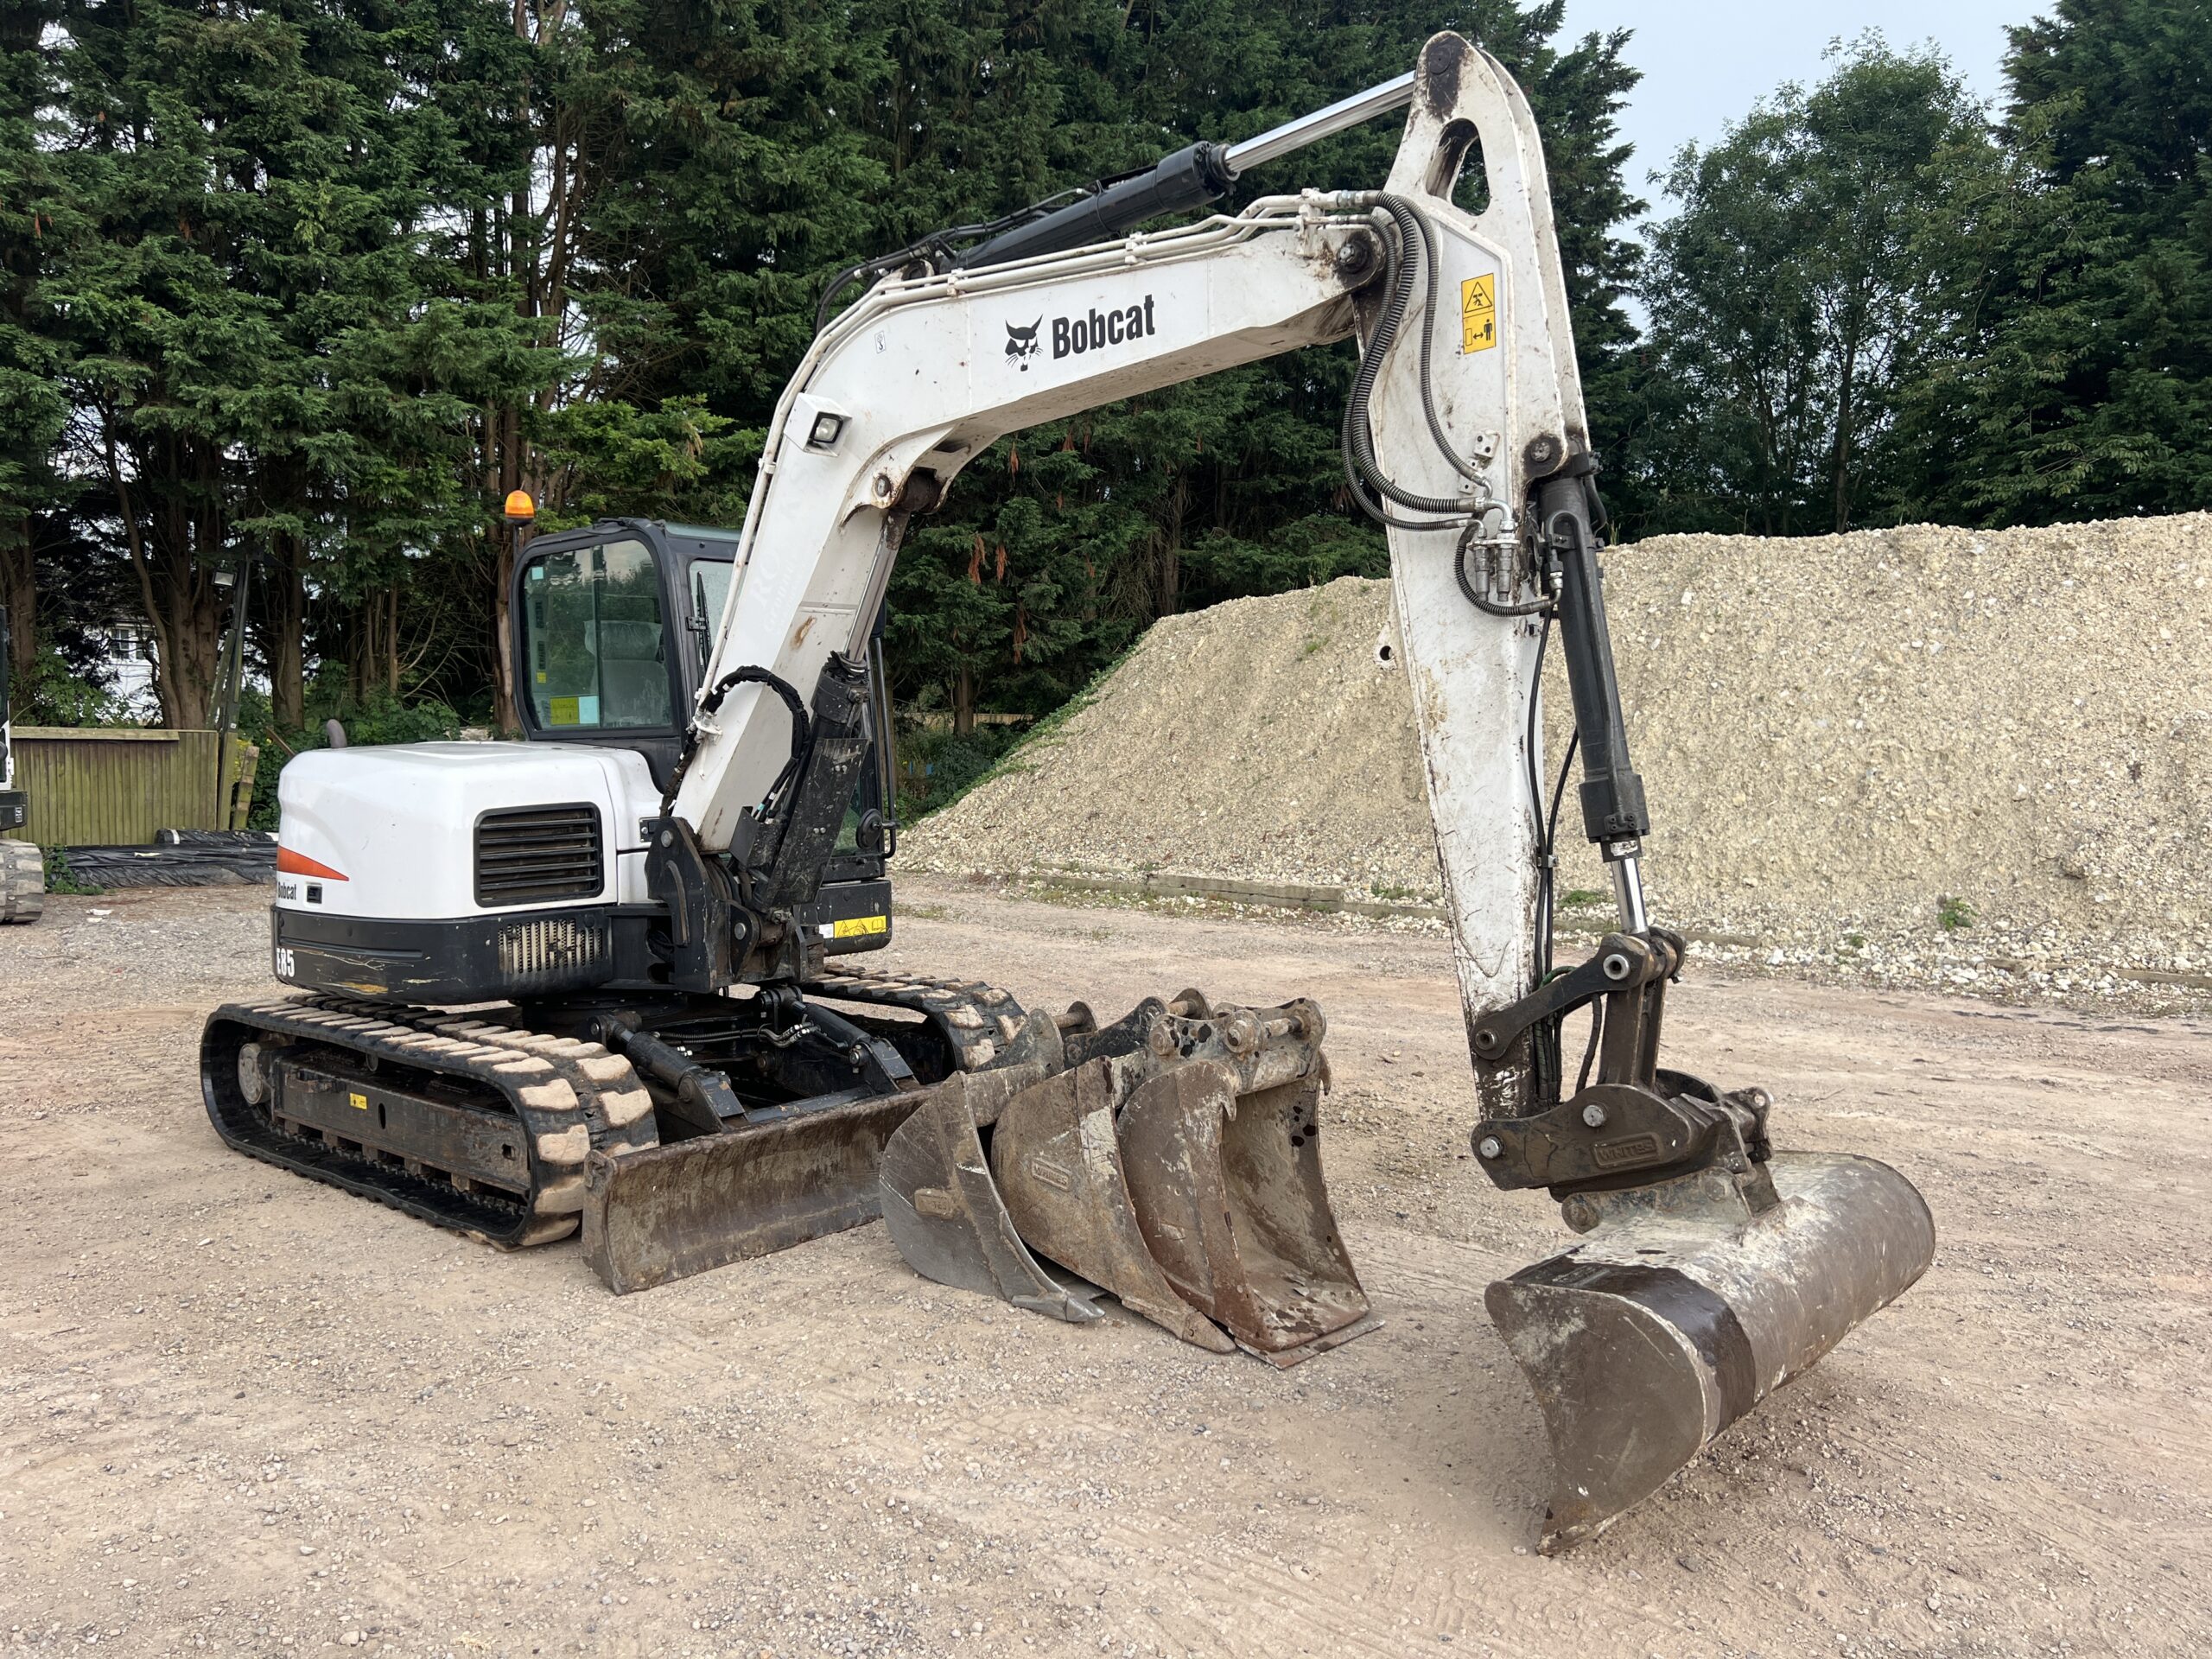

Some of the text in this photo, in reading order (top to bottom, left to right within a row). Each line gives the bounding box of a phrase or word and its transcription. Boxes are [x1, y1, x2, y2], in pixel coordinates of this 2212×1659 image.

[1052, 294, 1155, 359] Bobcat
[277, 880, 296, 900] Bobcat
[276, 947, 295, 977] E85
